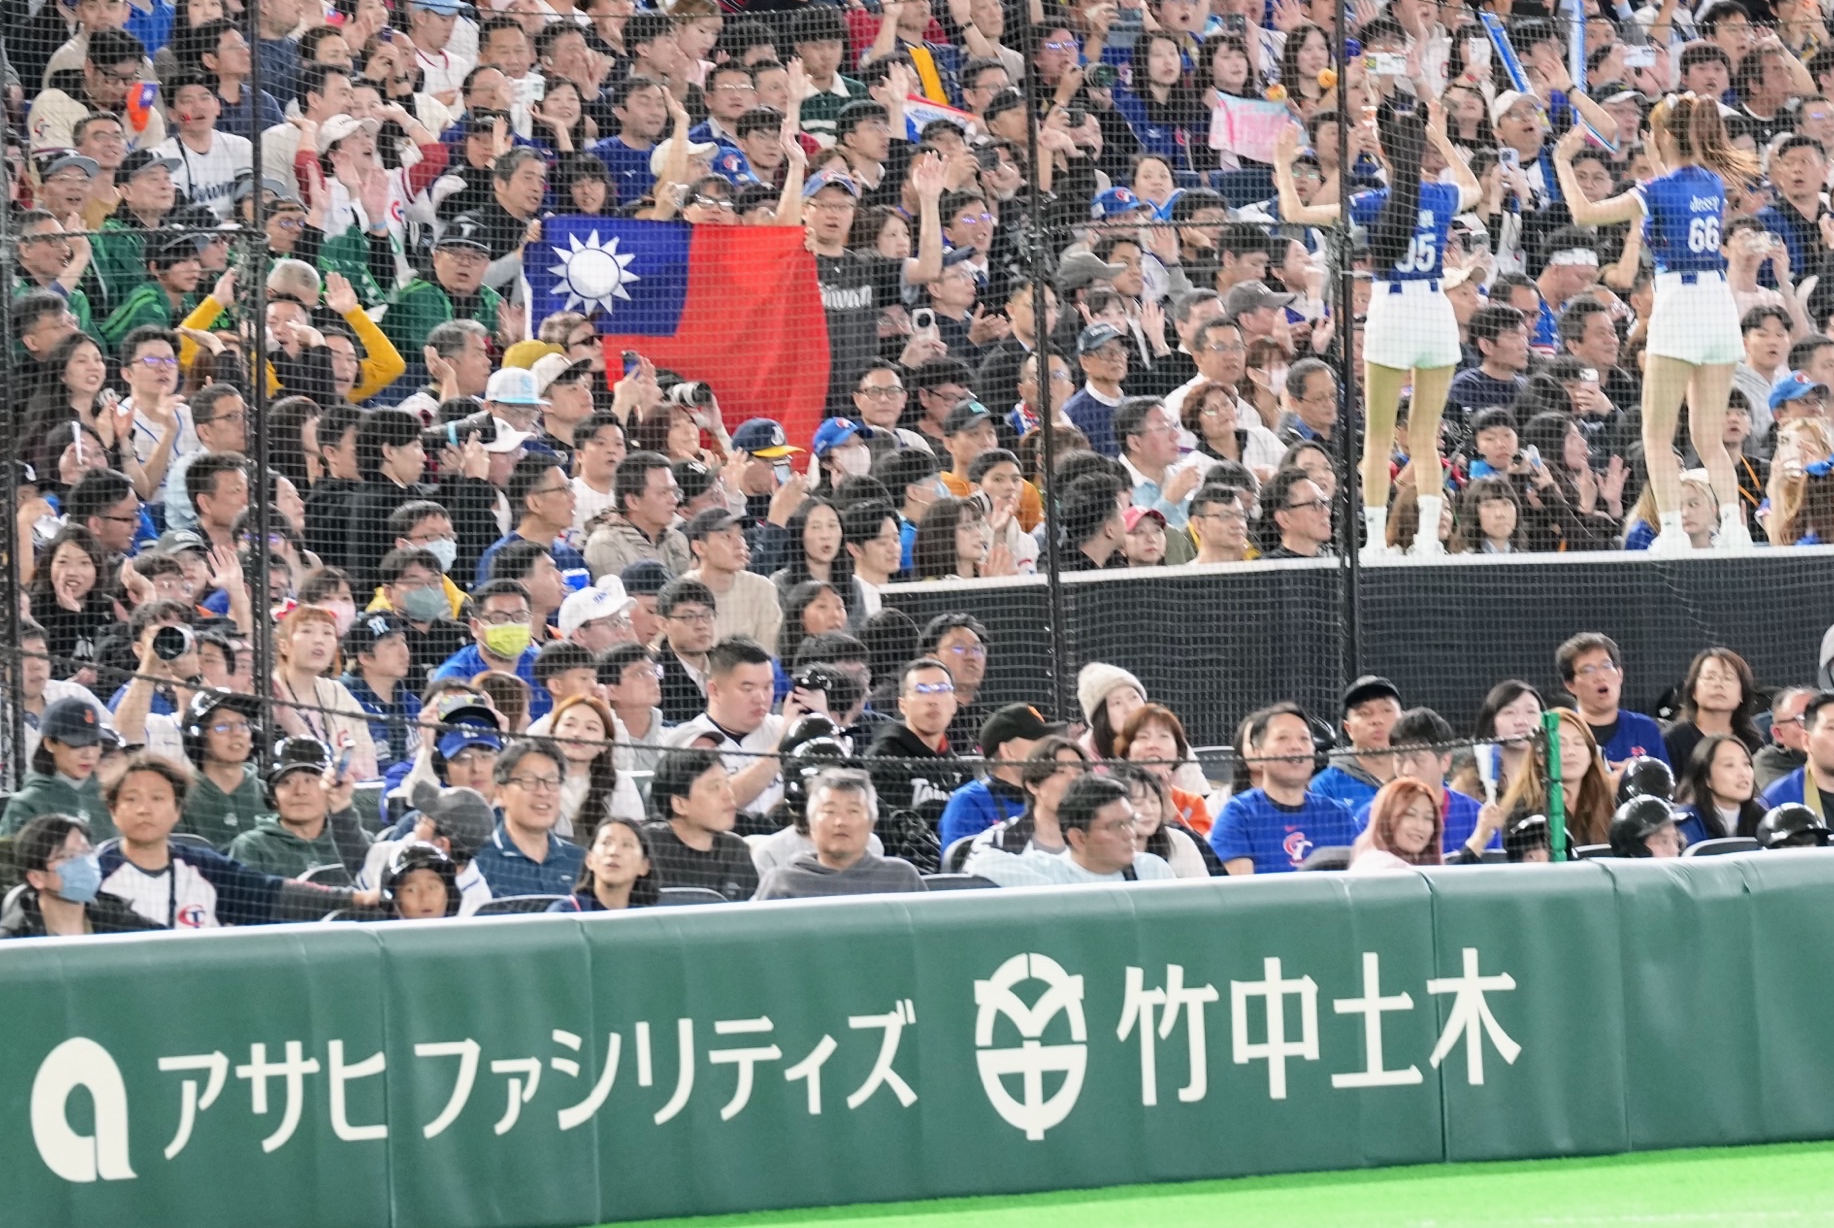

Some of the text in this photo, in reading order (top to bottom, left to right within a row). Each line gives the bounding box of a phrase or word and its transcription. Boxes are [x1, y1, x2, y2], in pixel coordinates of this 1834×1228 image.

[1687, 215, 1719, 253] 66
[1116, 946, 1523, 1107] 竹中土木
